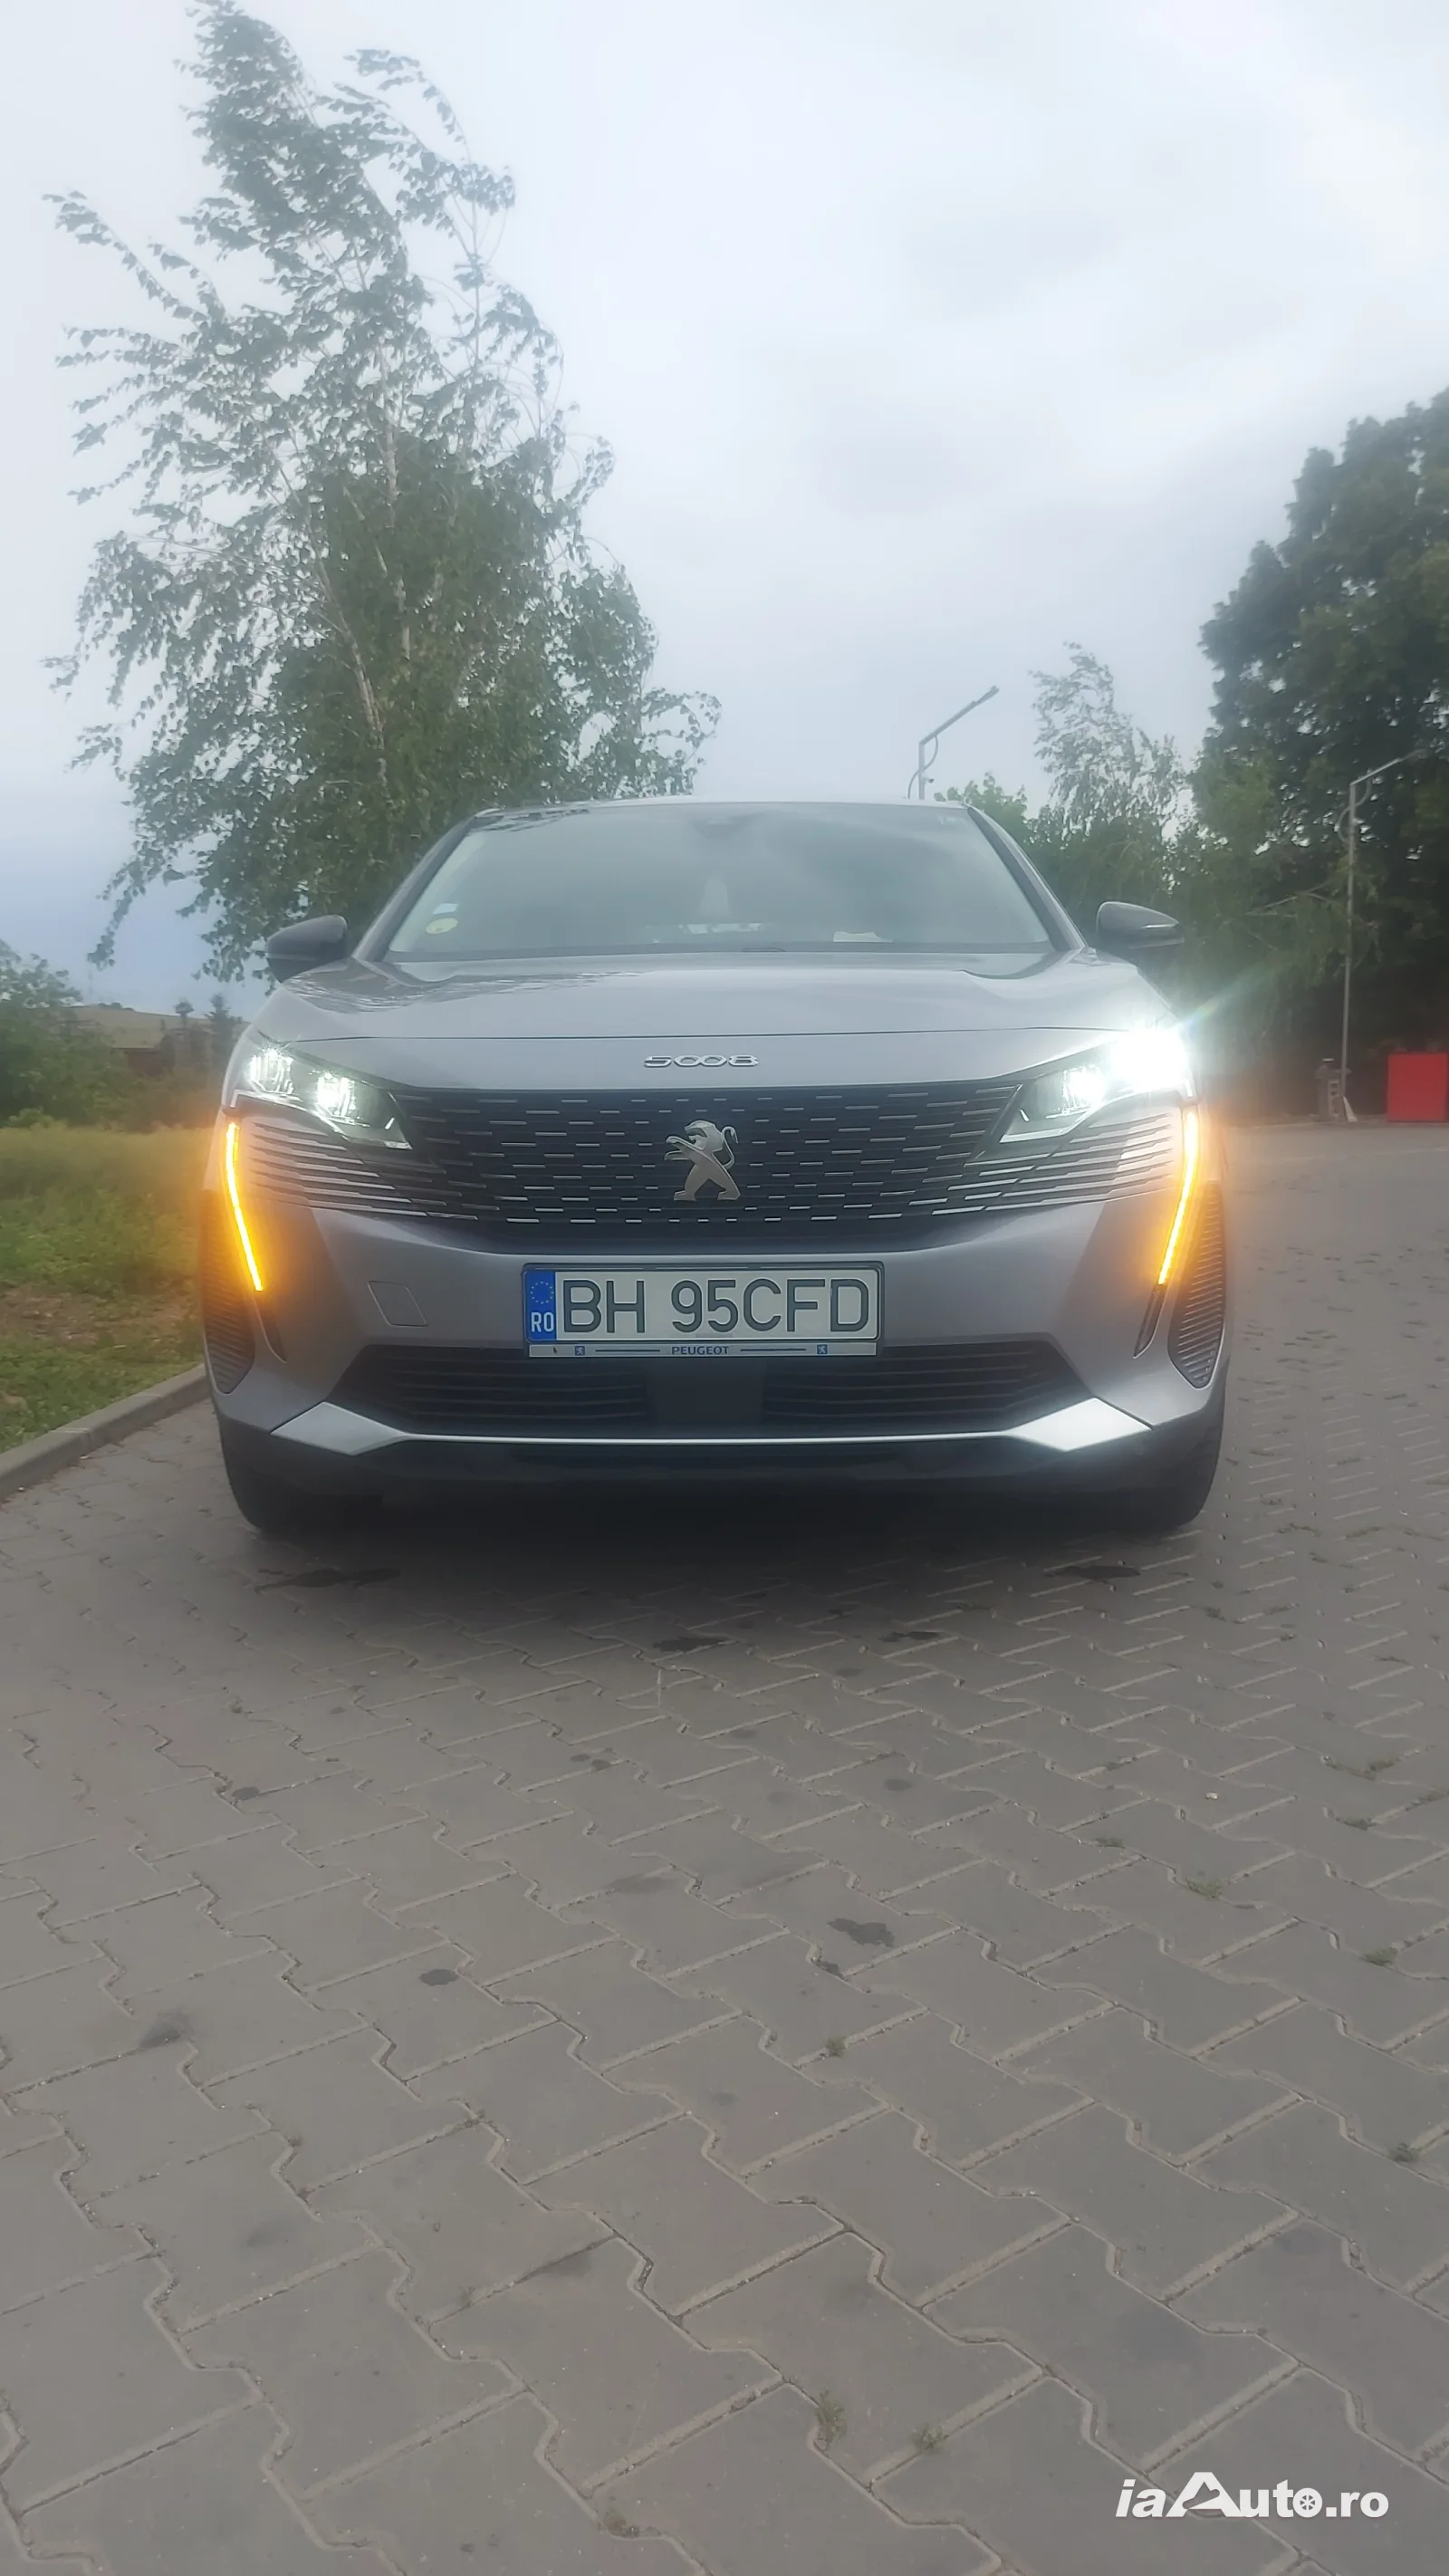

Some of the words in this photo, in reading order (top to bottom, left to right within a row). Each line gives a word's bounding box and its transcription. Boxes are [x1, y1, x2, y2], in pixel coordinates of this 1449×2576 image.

[643, 1054, 759, 1068] 5008
[562, 1279, 645, 1333] BH
[670, 1278, 869, 1333] 95CFD
[531, 1312, 554, 1332] RO
[670, 1345, 730, 1356] PEUGEOT
